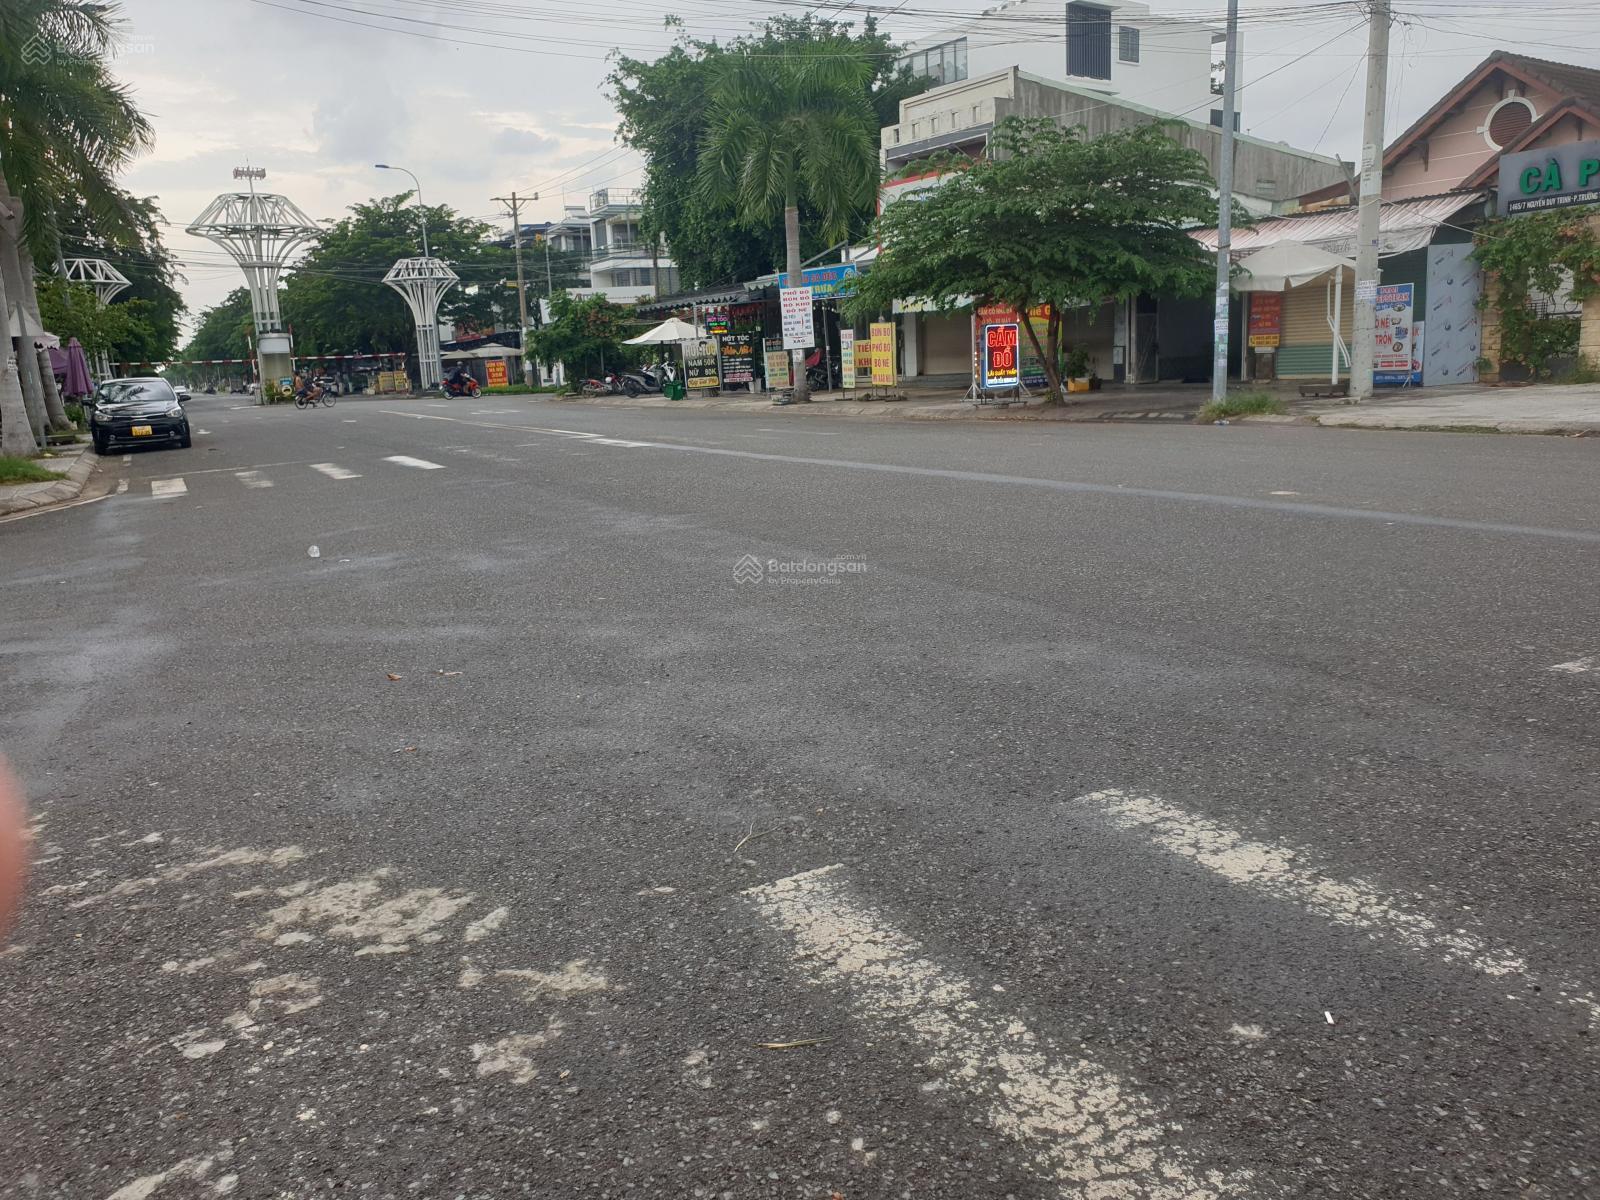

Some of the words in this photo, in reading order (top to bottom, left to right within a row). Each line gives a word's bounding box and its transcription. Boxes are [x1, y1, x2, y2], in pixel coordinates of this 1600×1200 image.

[1520, 159, 1562, 194] CÀ
[688, 359, 702, 367] NAM
[993, 346, 1011, 367] ĐỒ
